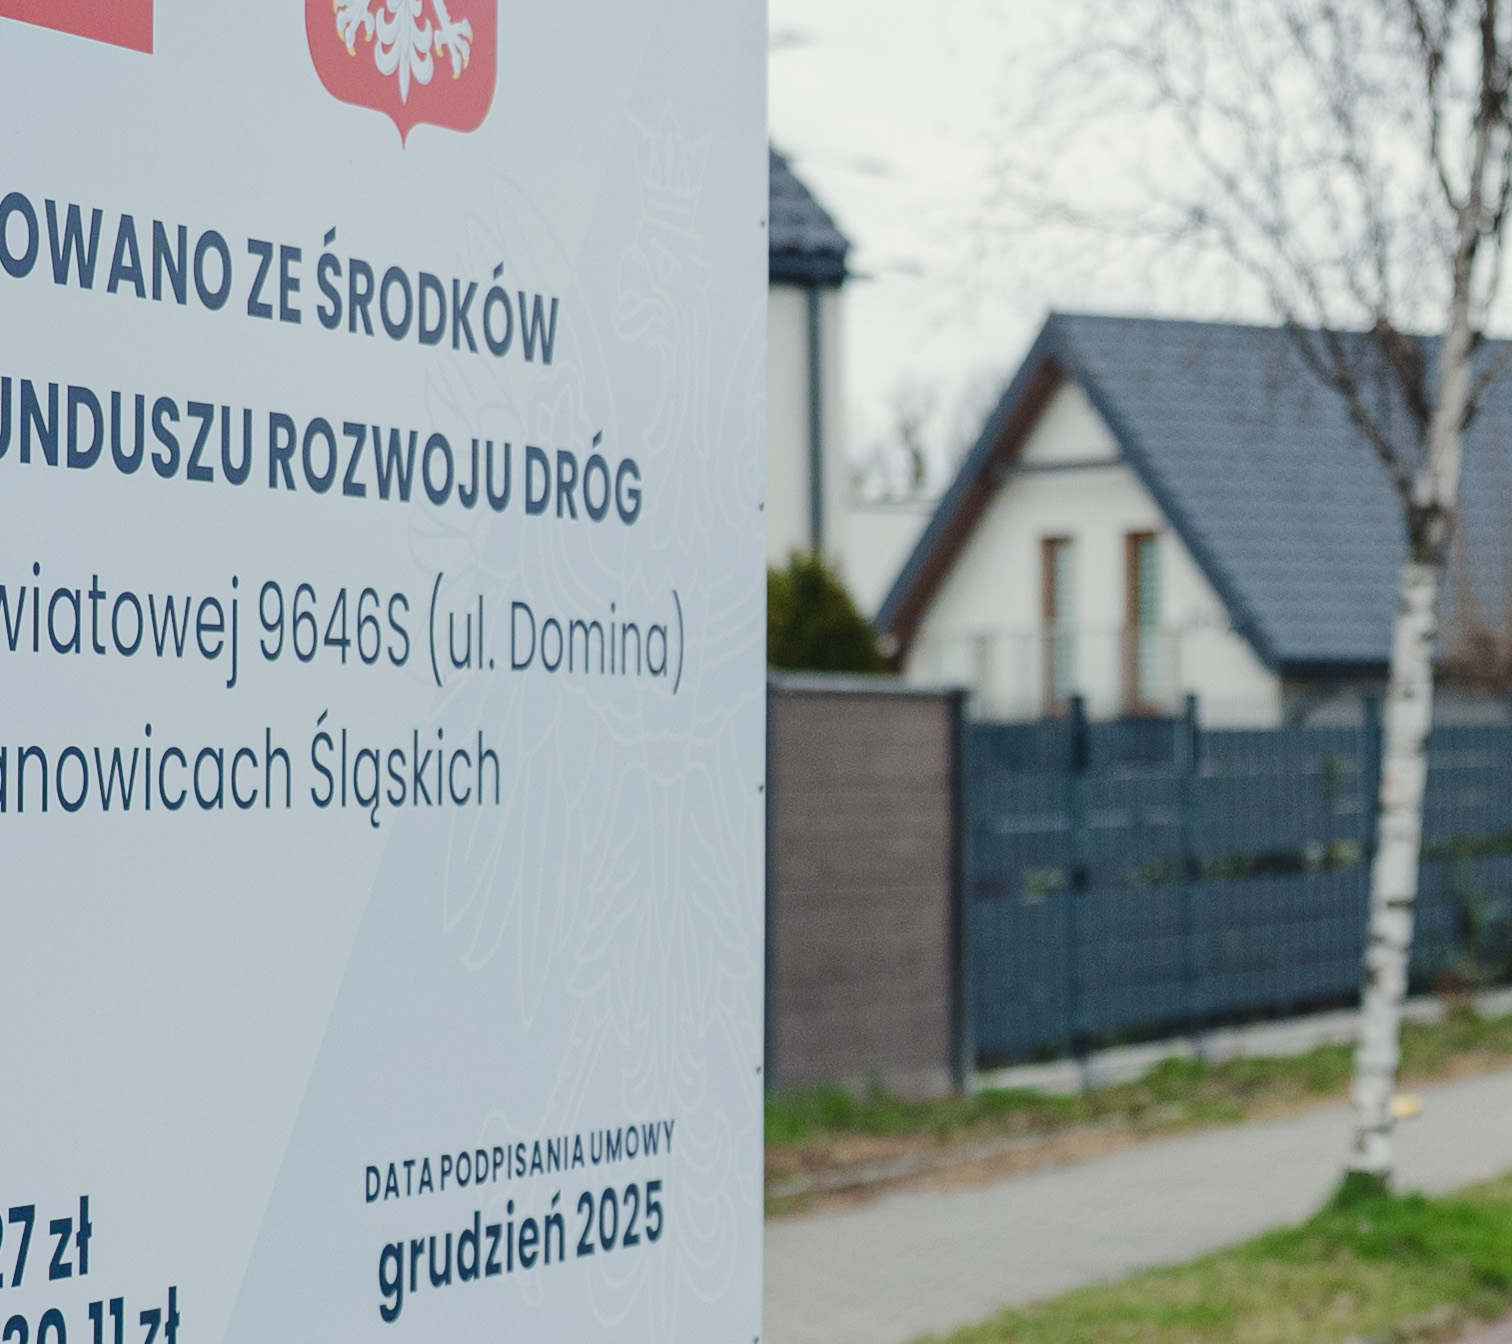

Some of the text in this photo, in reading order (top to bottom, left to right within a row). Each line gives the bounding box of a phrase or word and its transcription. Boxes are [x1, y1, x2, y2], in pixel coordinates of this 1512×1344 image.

[246, 237, 303, 325] ZE
[316, 227, 560, 366] ŚRODKÓW
[267, 411, 512, 513] ROZWOJU
[524, 431, 643, 527] DRÓG
[258, 579, 411, 668] 9646S
[428, 572, 496, 687] (ul.
[510, 591, 684, 693] Domina)
[310, 710, 501, 829] Śląskich
[364, 1120, 675, 1204] DATA PODPISANIA UMOWY
[47, 1194, 93, 1282] zł
[377, 1178, 665, 1325] grudzień 2025
